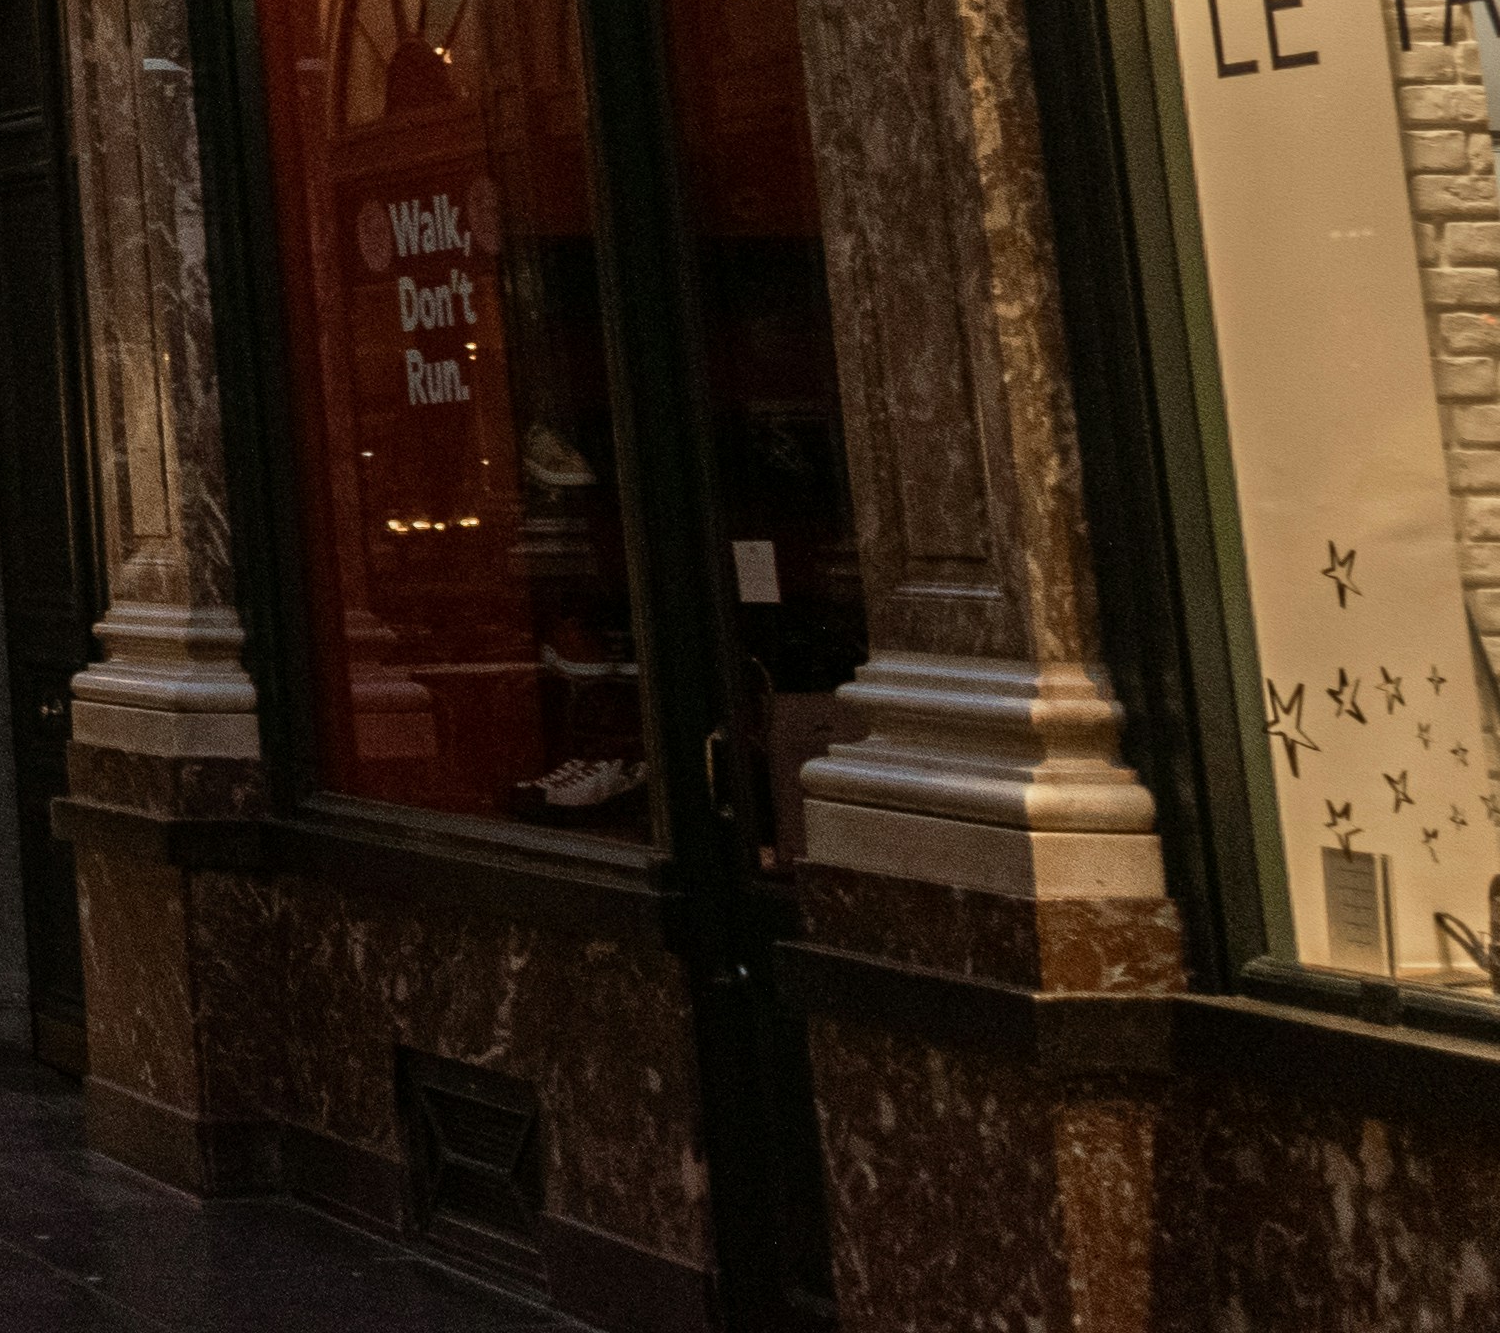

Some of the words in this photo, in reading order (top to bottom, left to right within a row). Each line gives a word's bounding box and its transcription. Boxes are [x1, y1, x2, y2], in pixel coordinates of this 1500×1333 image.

[388, 193, 472, 257] Walk,
[398, 268, 478, 332] Don't
[405, 347, 471, 406] Run.
